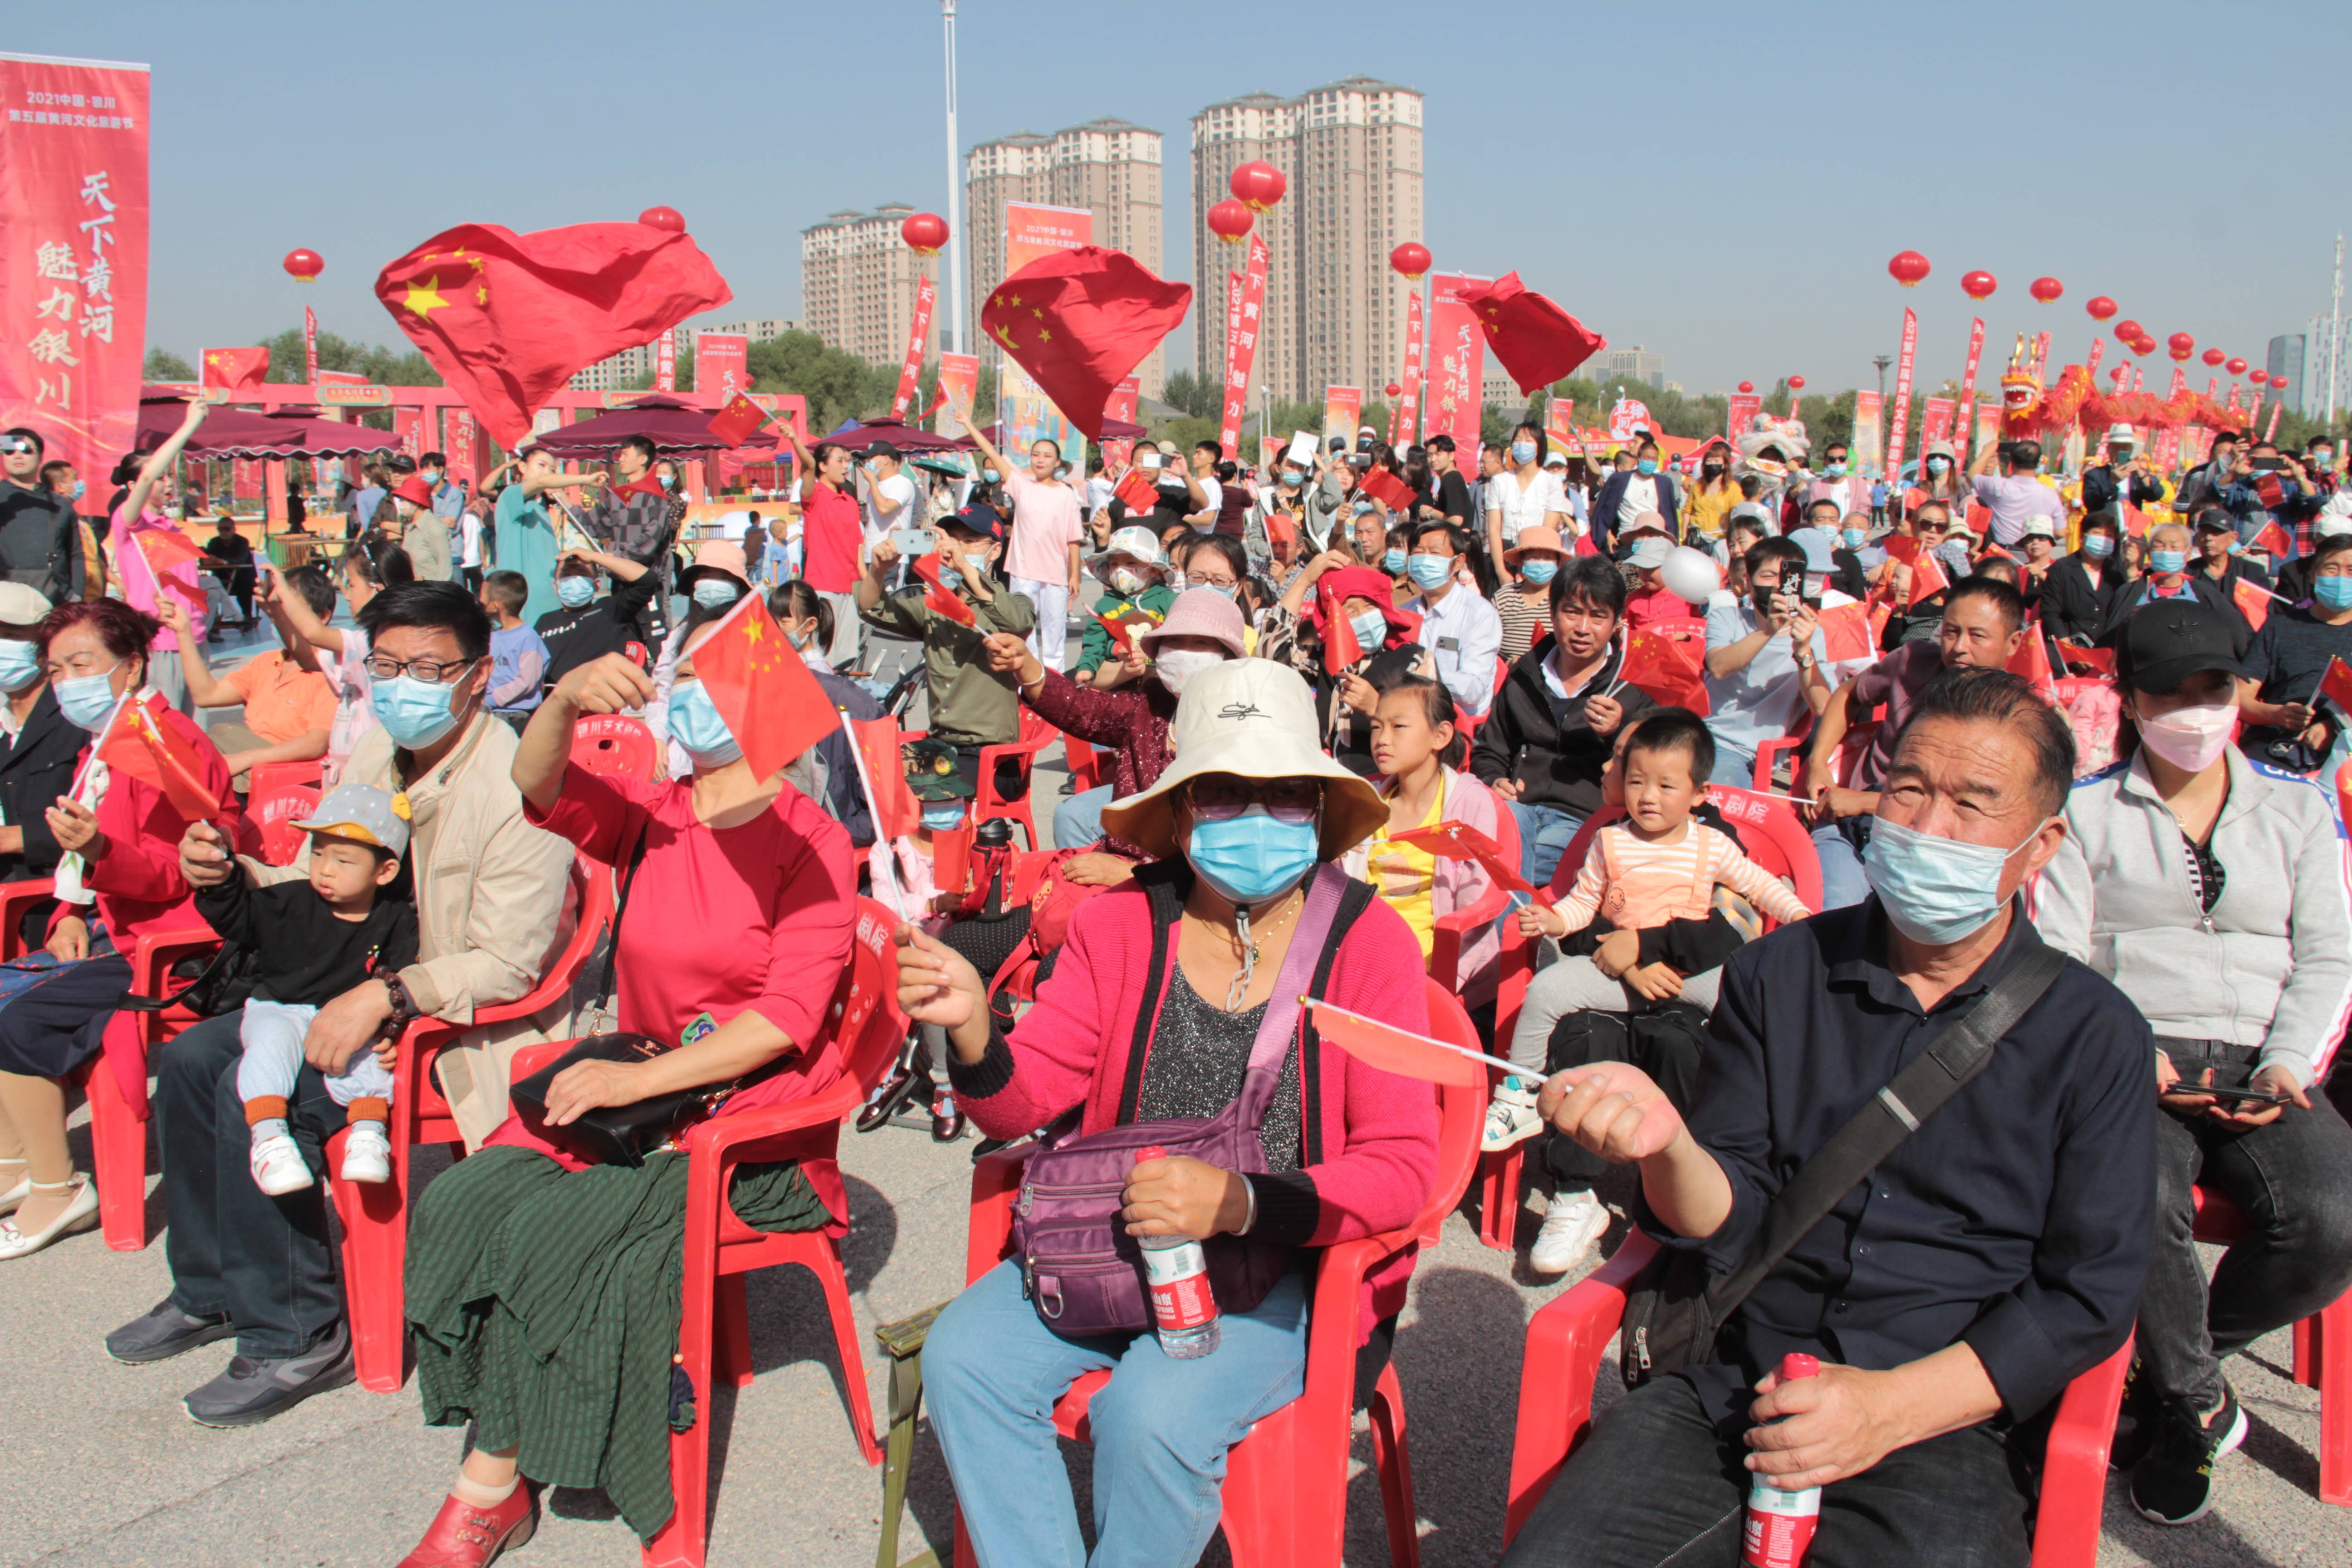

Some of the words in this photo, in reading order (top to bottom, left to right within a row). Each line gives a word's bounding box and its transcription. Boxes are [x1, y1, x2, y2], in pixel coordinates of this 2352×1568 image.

[80, 171, 116, 343] 天下黄河
[28, 240, 79, 411] 魅力银川
[896, 287, 932, 412] 天下黄河魅
[1457, 323, 1472, 402] 天下黄河
[1440, 354, 1458, 433] 魅力银川
[263, 797, 315, 824] 银川艺术剧
